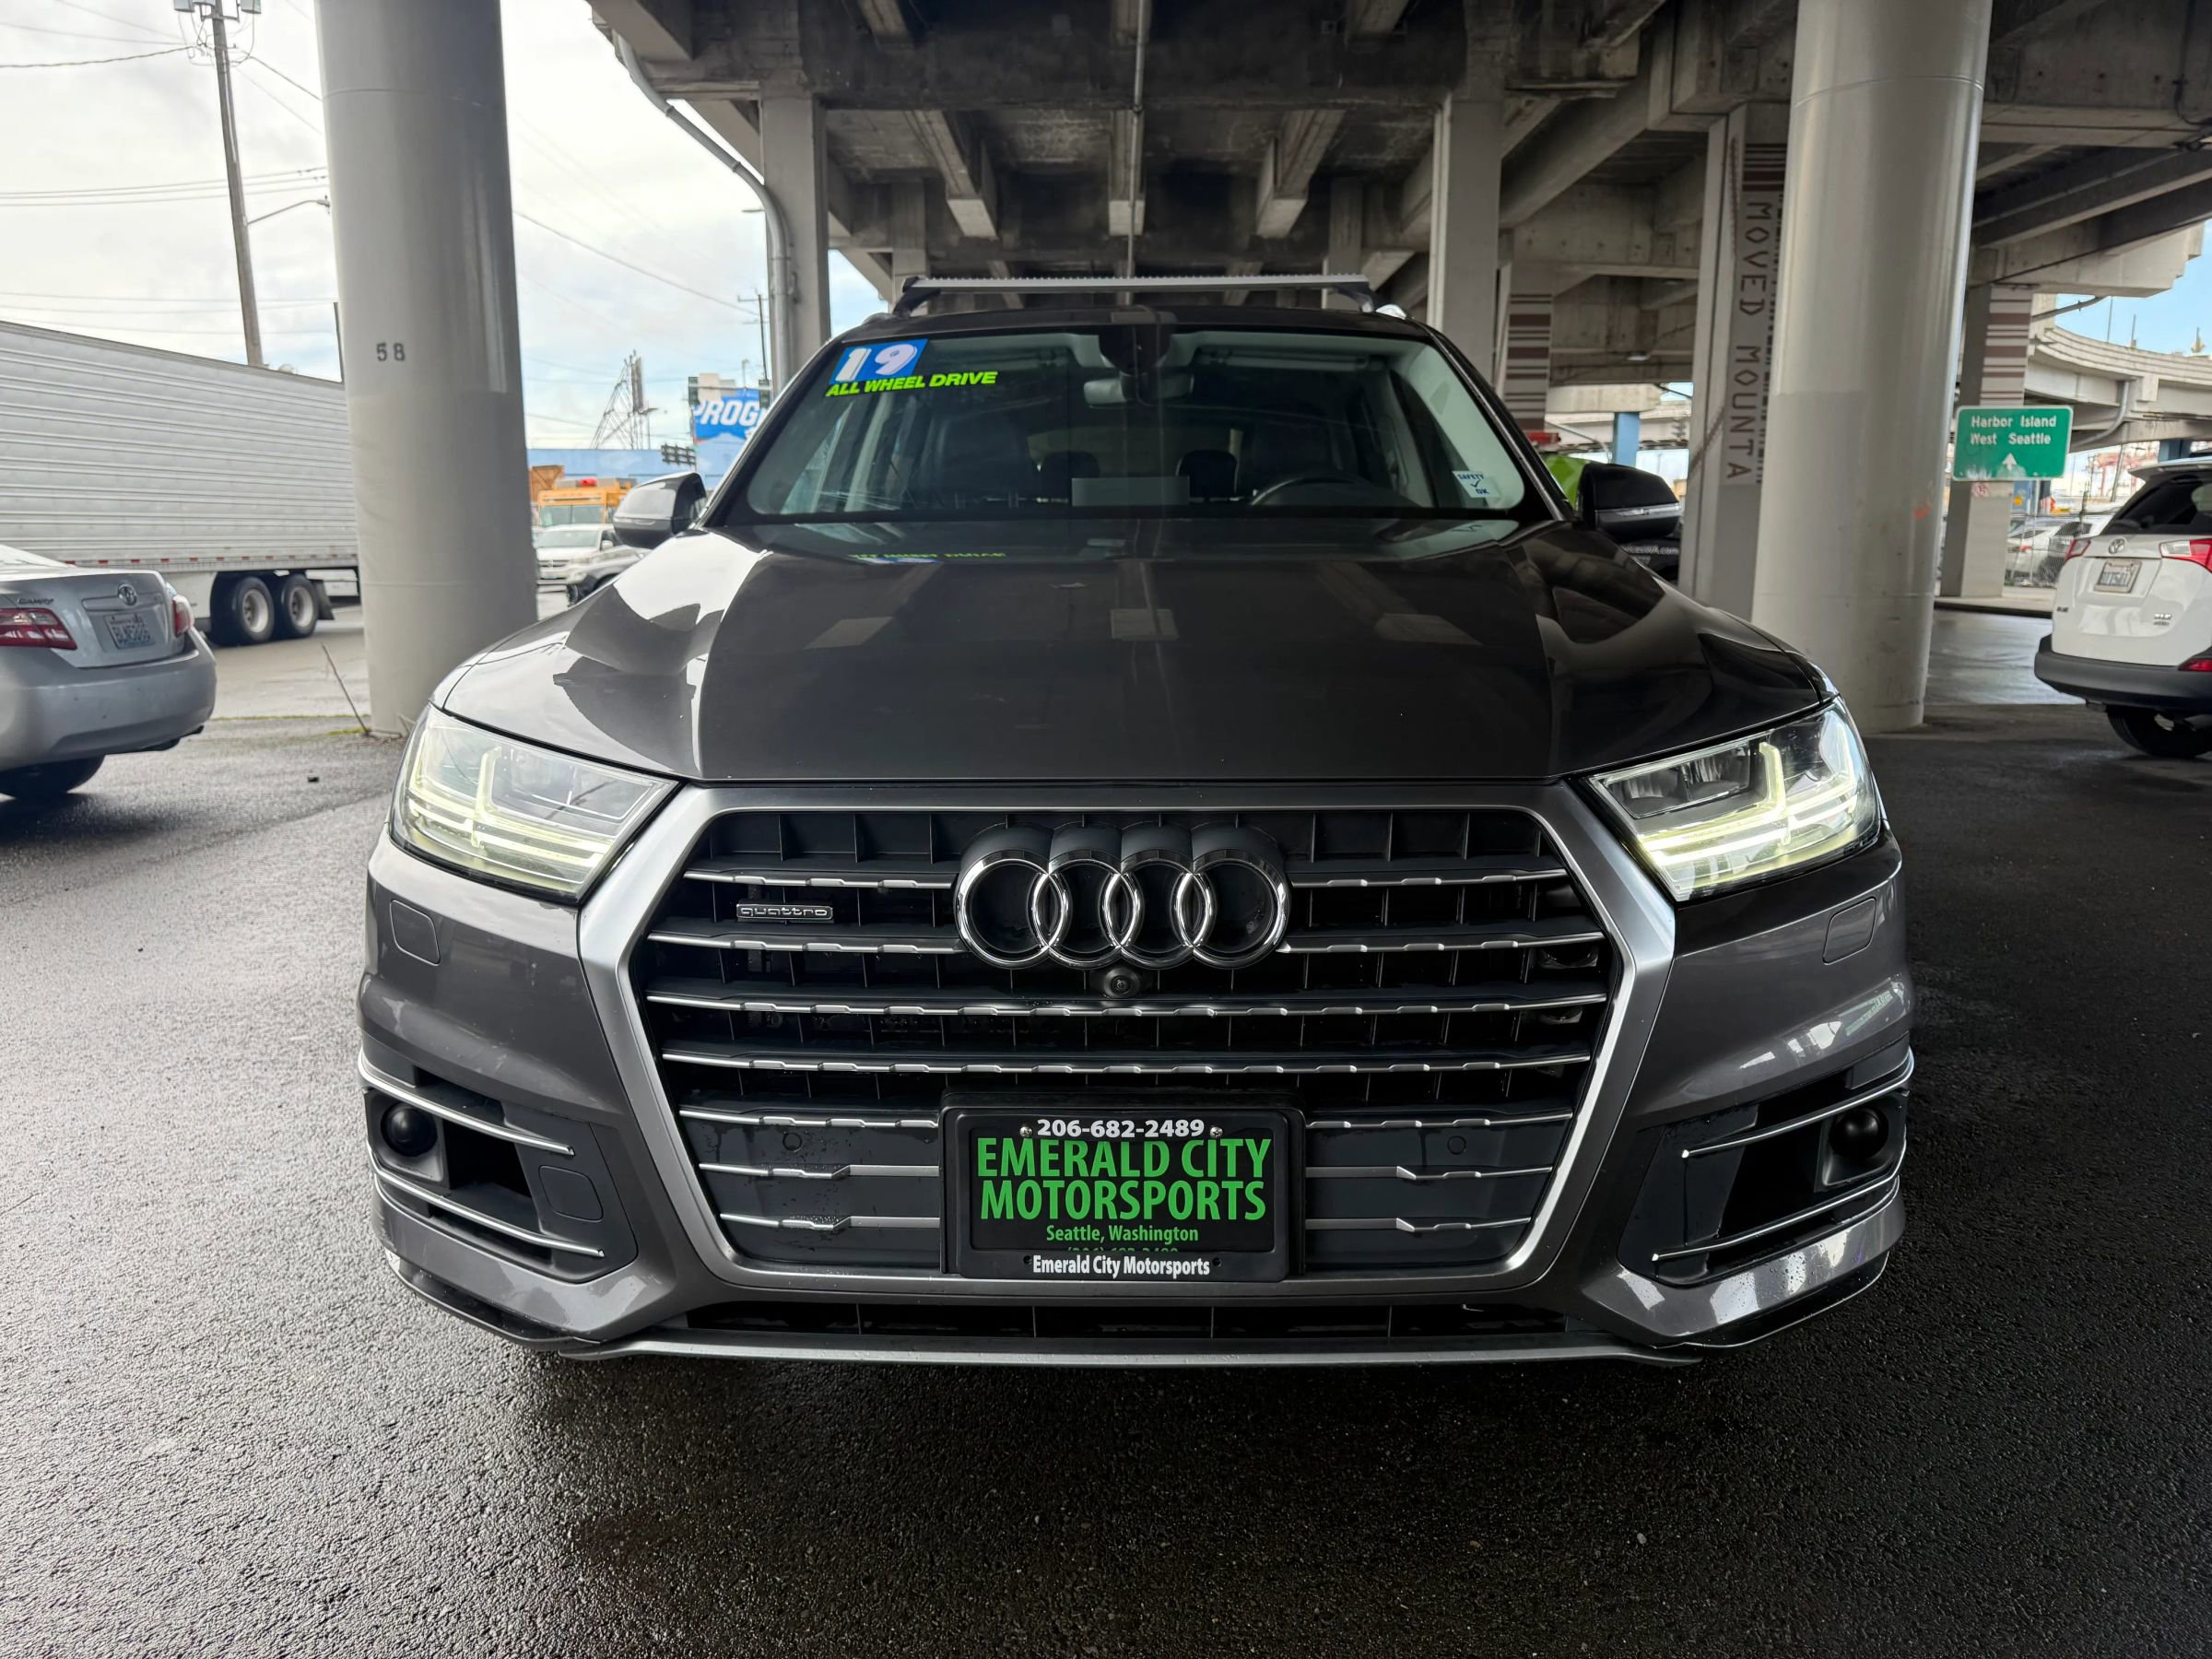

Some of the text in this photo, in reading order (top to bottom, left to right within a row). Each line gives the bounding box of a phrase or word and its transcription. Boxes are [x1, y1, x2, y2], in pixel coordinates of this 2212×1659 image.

[376, 342, 406, 361] 58
[1726, 202, 1772, 479] MOVED MOUNTA
[835, 344, 918, 382] 19
[825, 371, 999, 397] ALL WHEEL DRIVE
[1971, 415, 2057, 428] Harbor Island
[1970, 432, 2052, 445] West Seattle
[740, 907, 828, 917] quattro
[1037, 1119, 1205, 1138] 206-682-2489
[977, 1137, 1272, 1178] EMERALD CITY
[980, 1179, 1266, 1221] MOTORSPORTS
[1046, 1224, 1199, 1245] Seattle, Washington
[1032, 1254, 1211, 1279] Emerald City Motorsports
